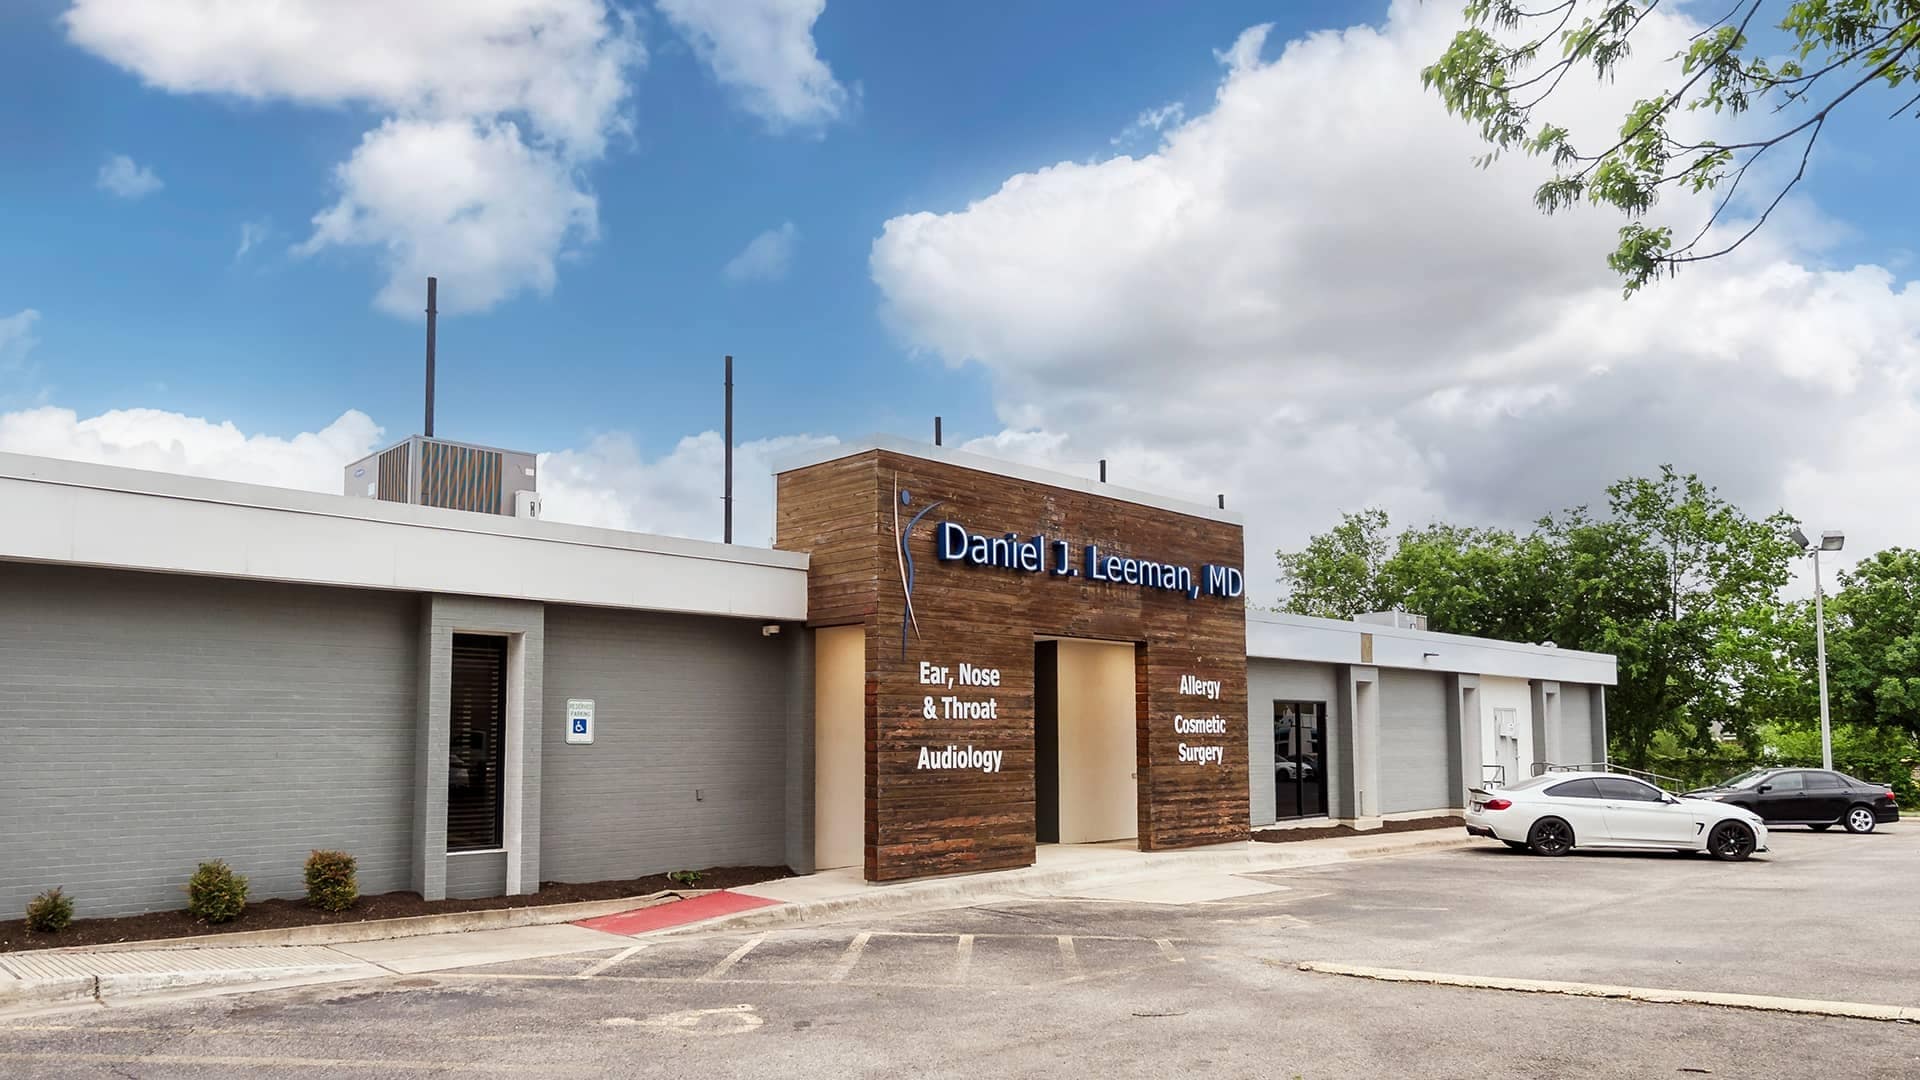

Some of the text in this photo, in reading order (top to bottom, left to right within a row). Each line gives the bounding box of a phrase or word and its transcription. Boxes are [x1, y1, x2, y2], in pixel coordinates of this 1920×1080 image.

[939, 521, 1244, 600] Daniel J. Leeman, MD
[919, 661, 1001, 690] Ear, Nose
[1179, 674, 1221, 700] Allergy
[923, 696, 998, 720] & Throat
[1174, 714, 1226, 734] Cosmetic
[917, 745, 1003, 773] Audiology
[1178, 742, 1224, 766] Surgery
